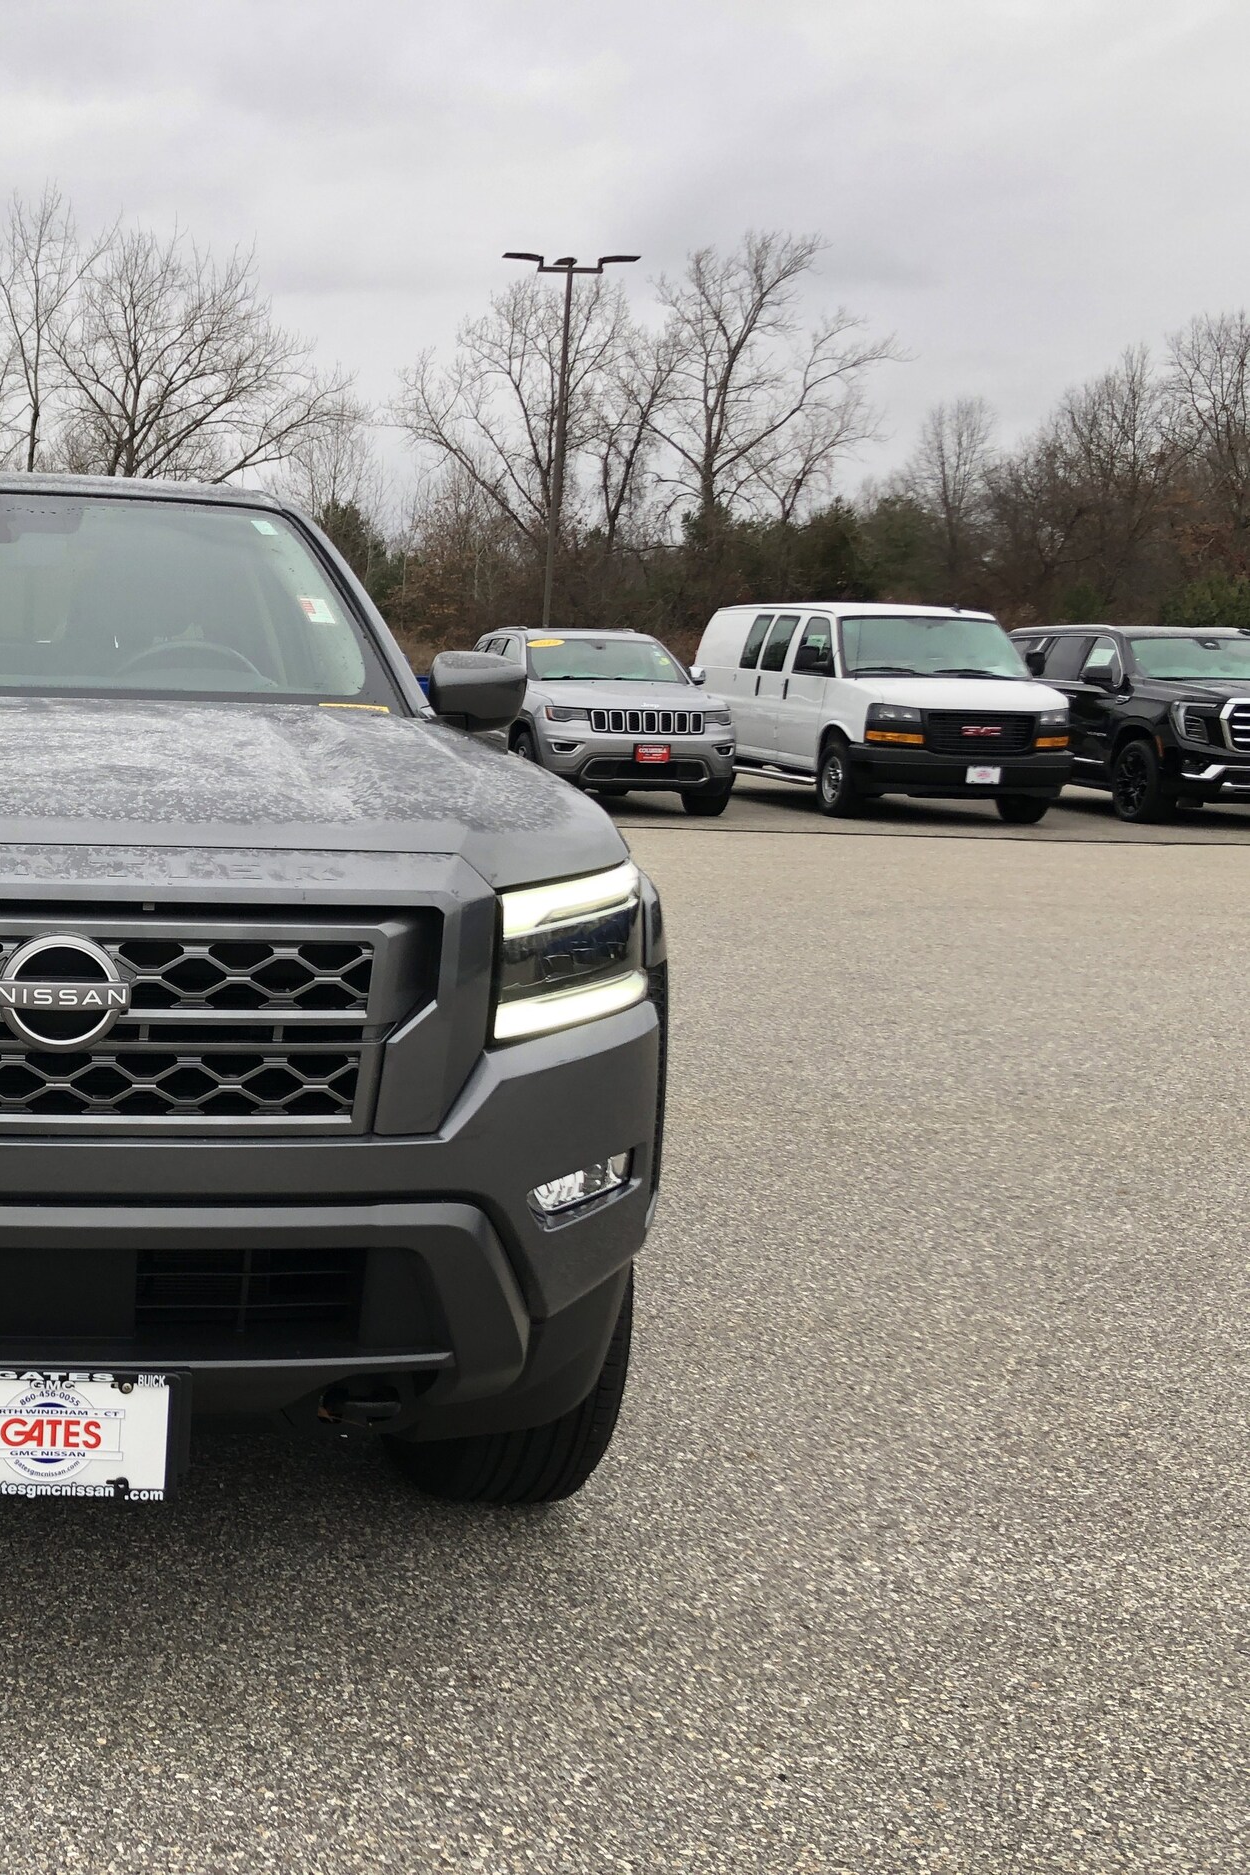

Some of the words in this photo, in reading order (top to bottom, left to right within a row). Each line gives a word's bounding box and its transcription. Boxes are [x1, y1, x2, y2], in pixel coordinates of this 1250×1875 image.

[30, 1380, 76, 1391] GMC
[137, 1374, 166, 1387] BUICK
[19, 1390, 81, 1407] 860-456-0055
[25, 1408, 89, 1416] WINDHAM
[0, 1417, 102, 1450] GATES
[40, 1450, 86, 1458] NISSAN
[13, 1458, 81, 1478] gatesgmcnissan.com
